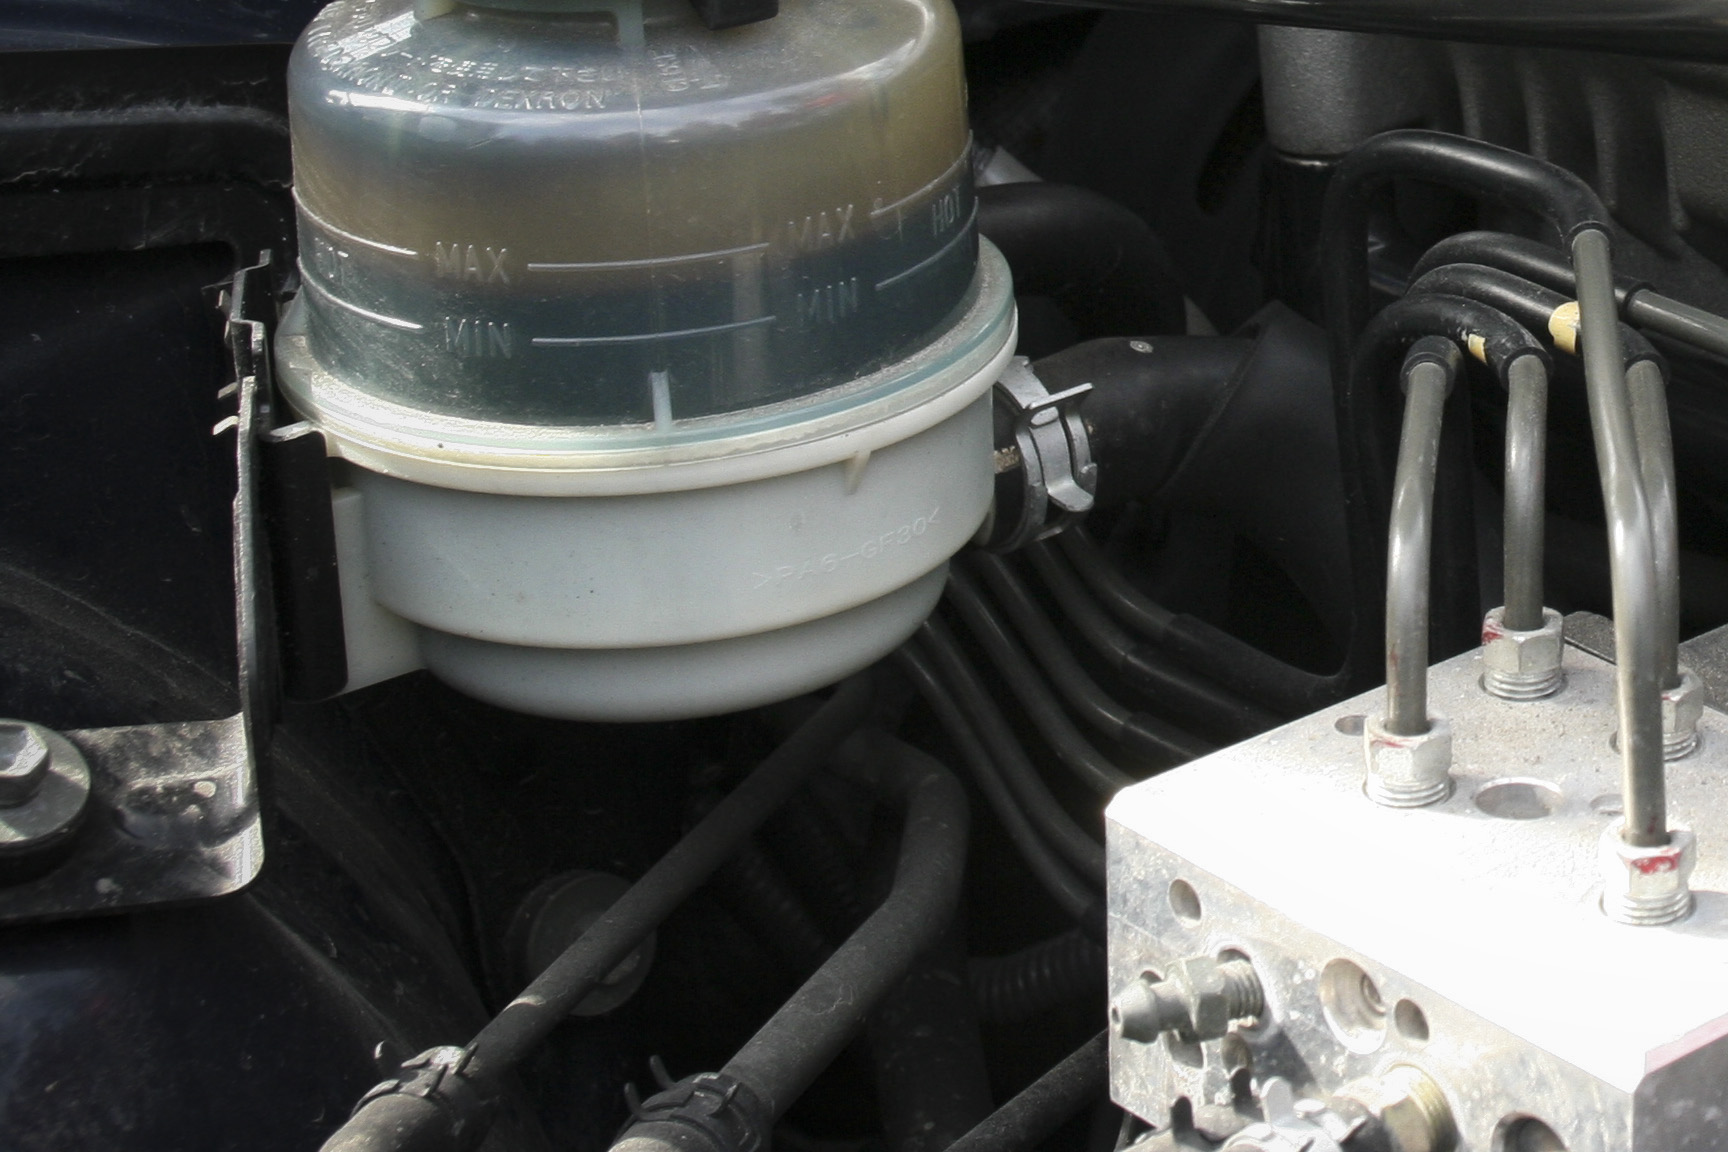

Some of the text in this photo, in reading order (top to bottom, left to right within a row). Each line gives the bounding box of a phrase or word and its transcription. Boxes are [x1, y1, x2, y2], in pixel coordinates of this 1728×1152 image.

[787, 203, 856, 252] MAX
[932, 184, 962, 239] HOT
[433, 239, 512, 285] MAX
[796, 275, 858, 326] MIN
[443, 314, 513, 360] MIN
